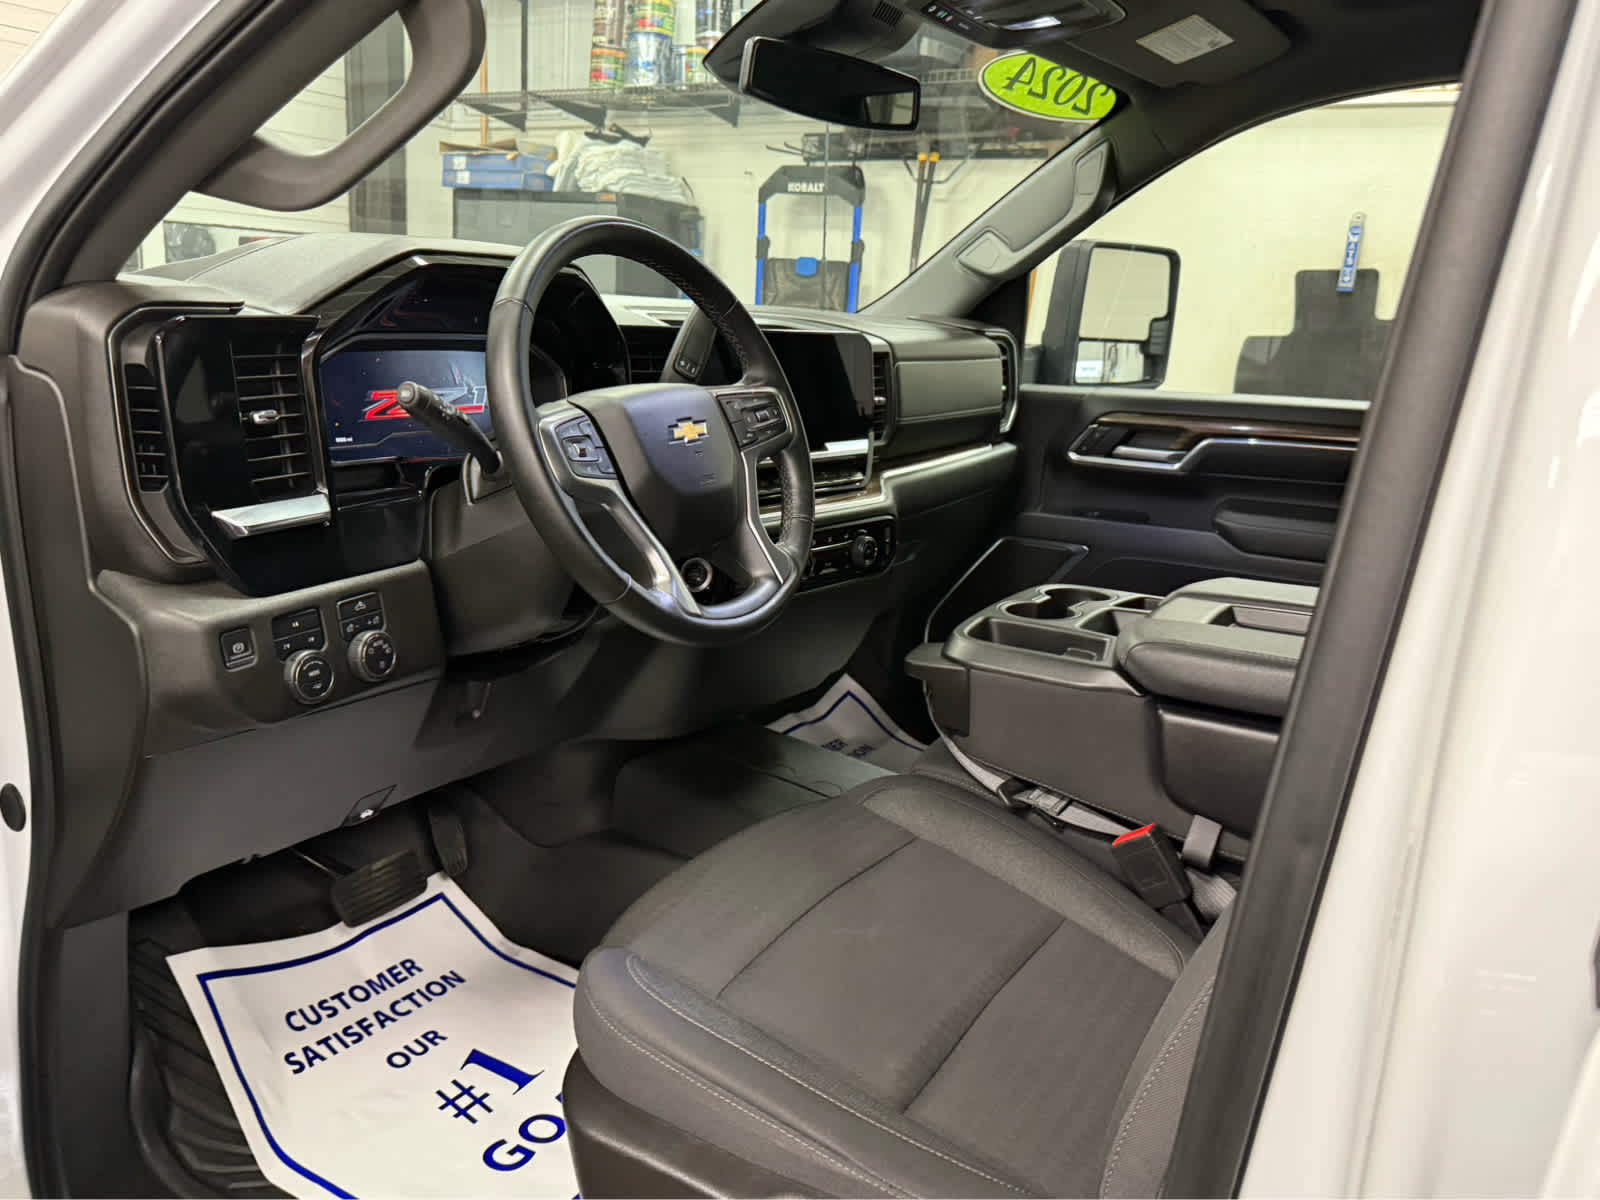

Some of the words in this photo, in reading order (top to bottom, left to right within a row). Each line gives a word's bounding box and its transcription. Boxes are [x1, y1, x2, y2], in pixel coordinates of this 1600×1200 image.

[787, 181, 825, 193] KOBALT
[284, 970, 467, 1075] SATISFACTION
[285, 958, 424, 1032] CUSTOMER
[386, 1030, 448, 1069] OUR
[435, 1048, 545, 1124] #1
[482, 1092, 566, 1172] GO
